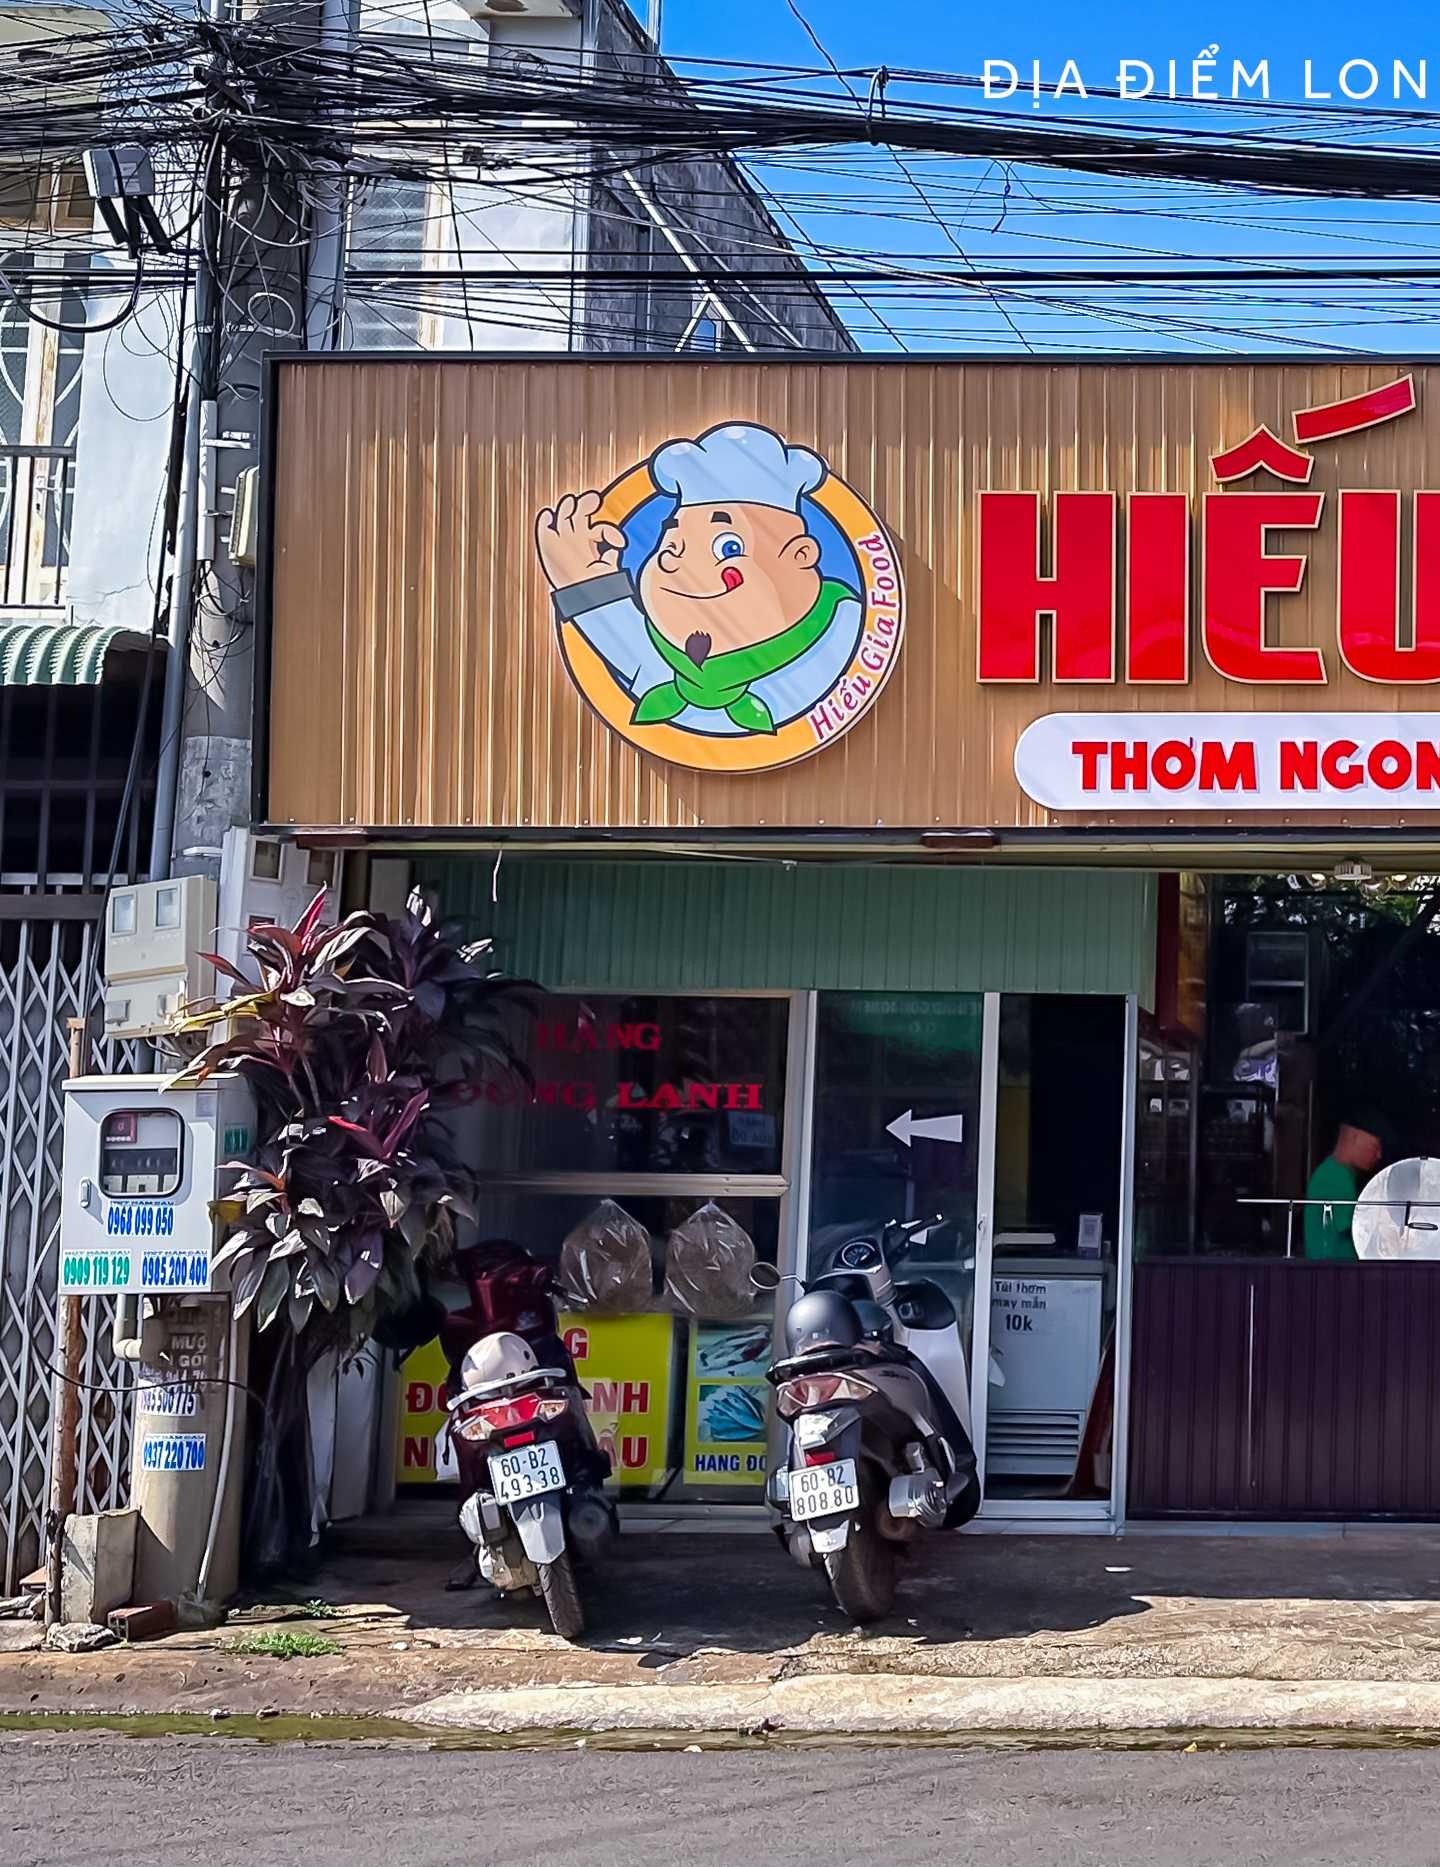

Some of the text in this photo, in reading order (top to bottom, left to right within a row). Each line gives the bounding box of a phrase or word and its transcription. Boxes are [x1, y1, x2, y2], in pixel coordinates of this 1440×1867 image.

[810, 533, 897, 740] Hiếu Gia Food
[1072, 737, 1257, 790] THƠM
[1006, 1314, 1033, 1332] 10k
